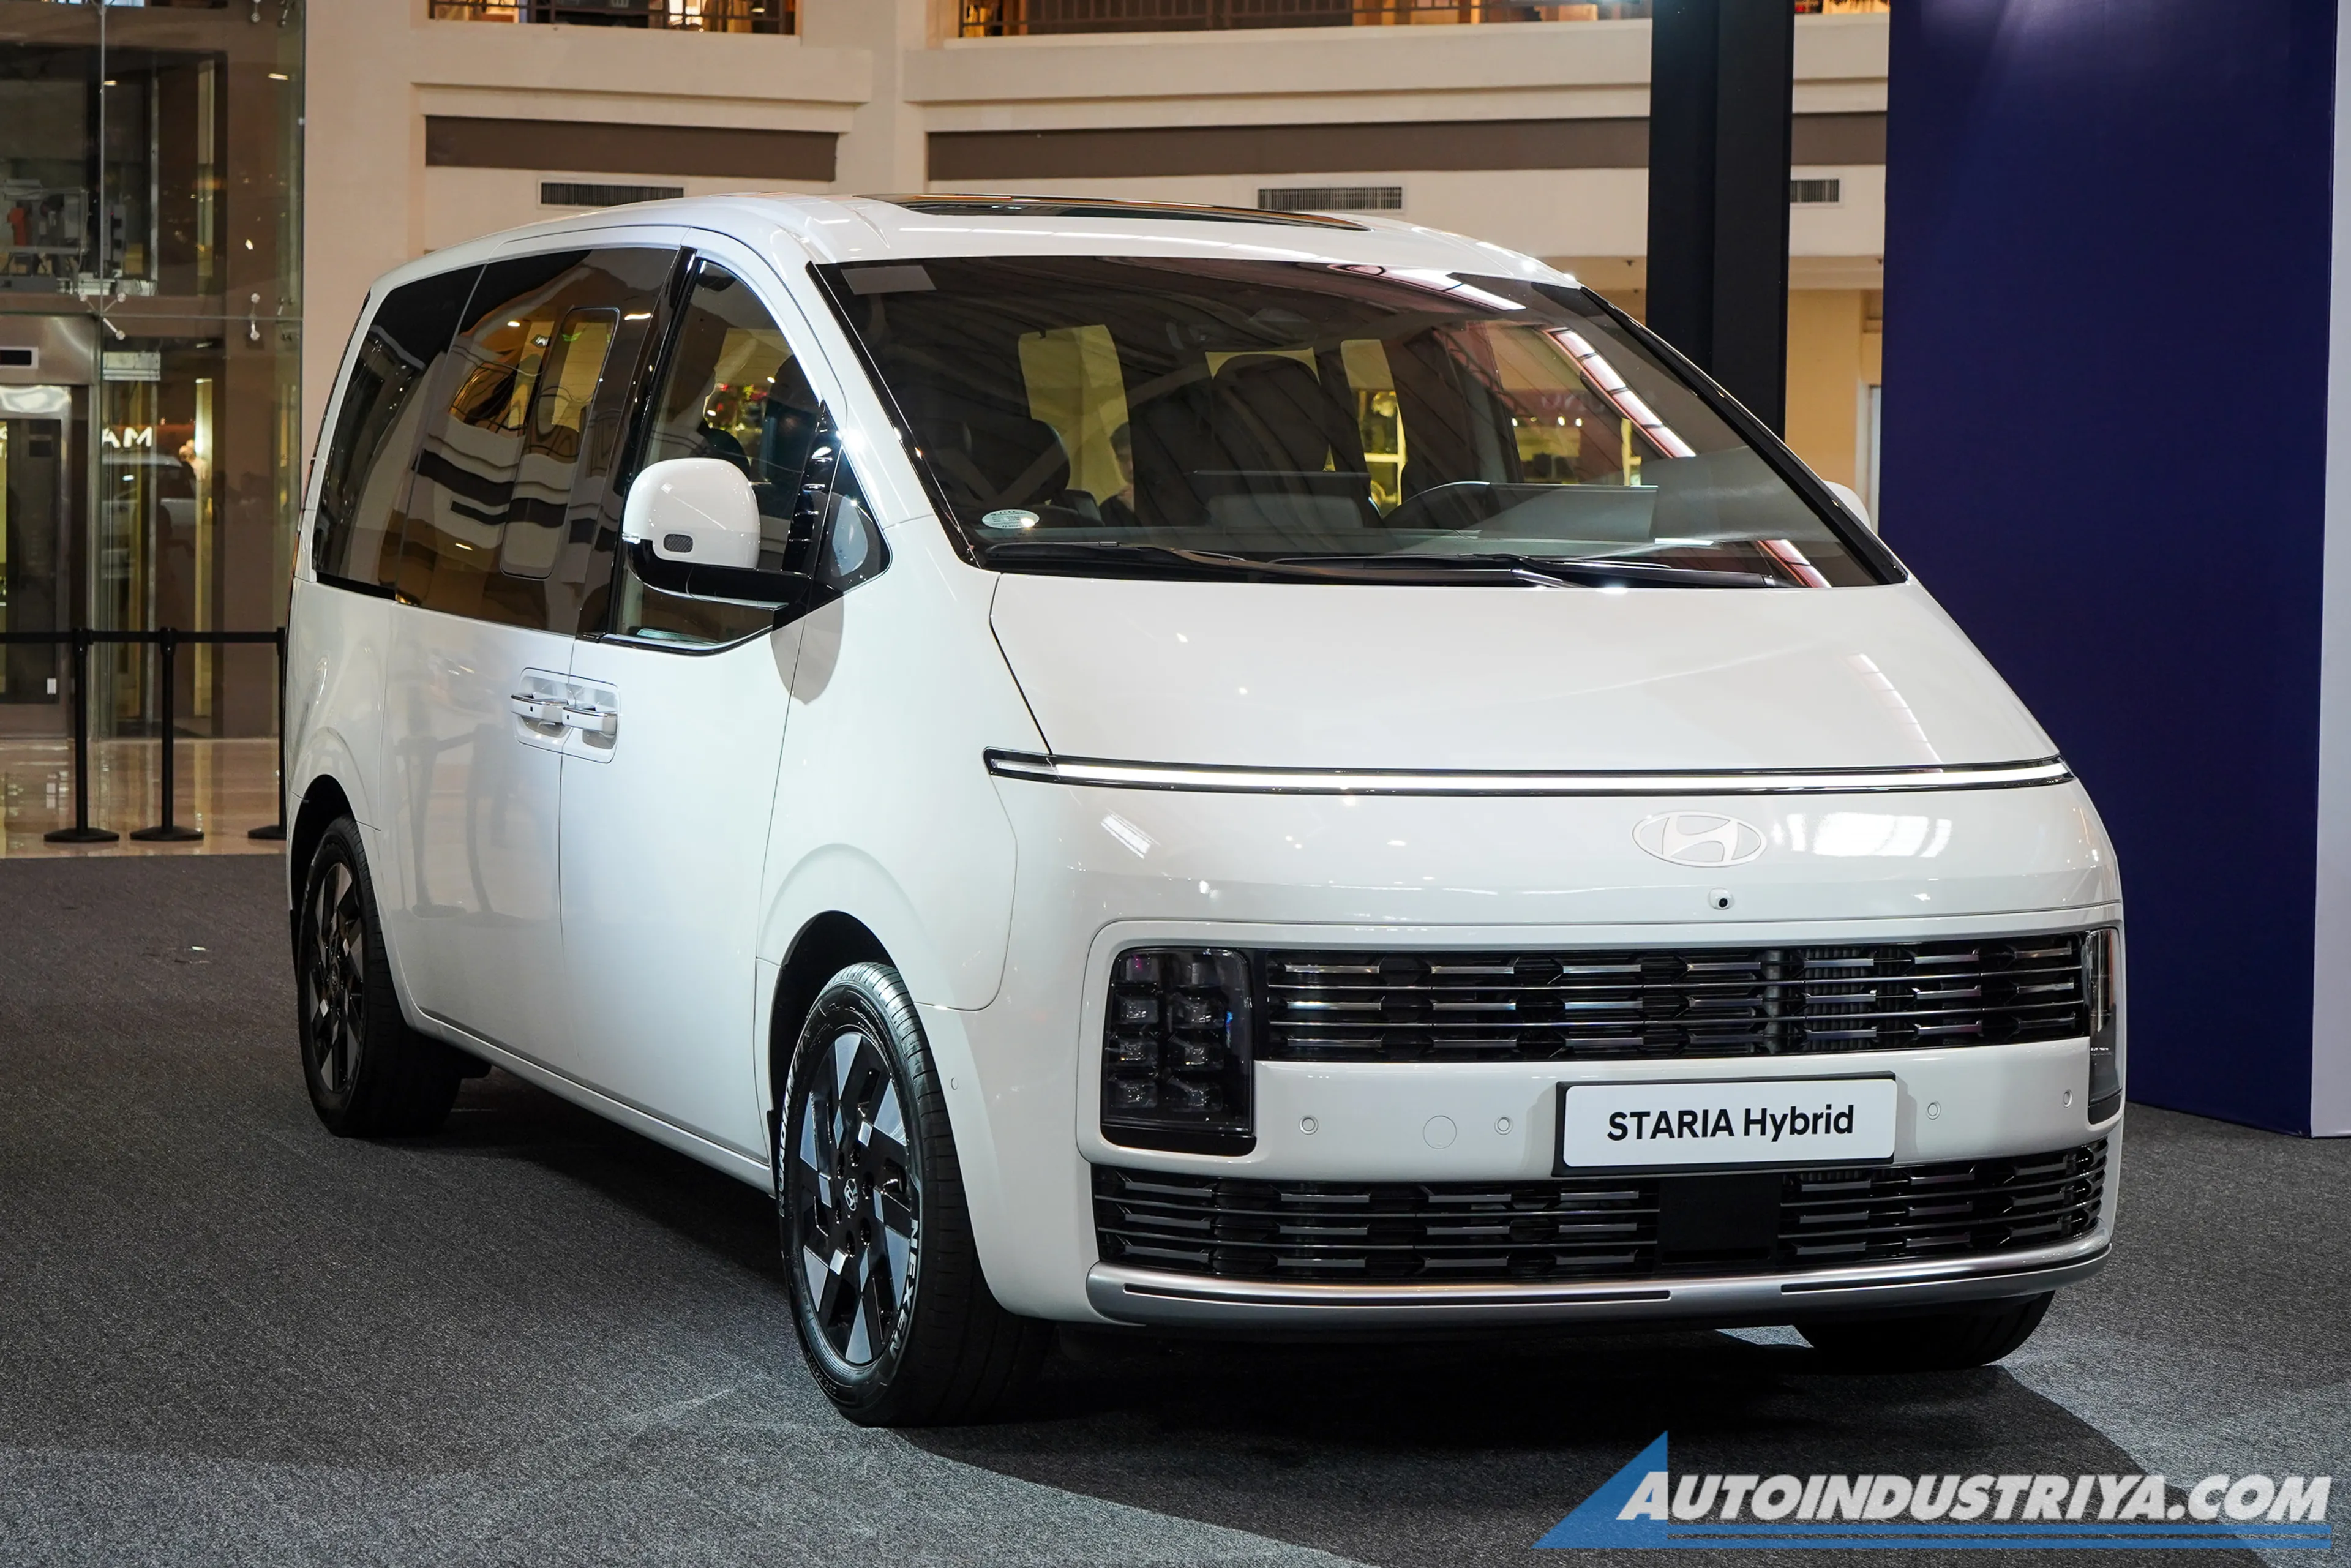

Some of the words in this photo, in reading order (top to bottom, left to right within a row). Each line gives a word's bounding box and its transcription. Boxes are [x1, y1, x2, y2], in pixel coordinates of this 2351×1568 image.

[1607, 1109, 1734, 1141] STARIA
[1744, 1104, 1854, 1142] Hybrid
[890, 1217, 918, 1361] NEXEN
